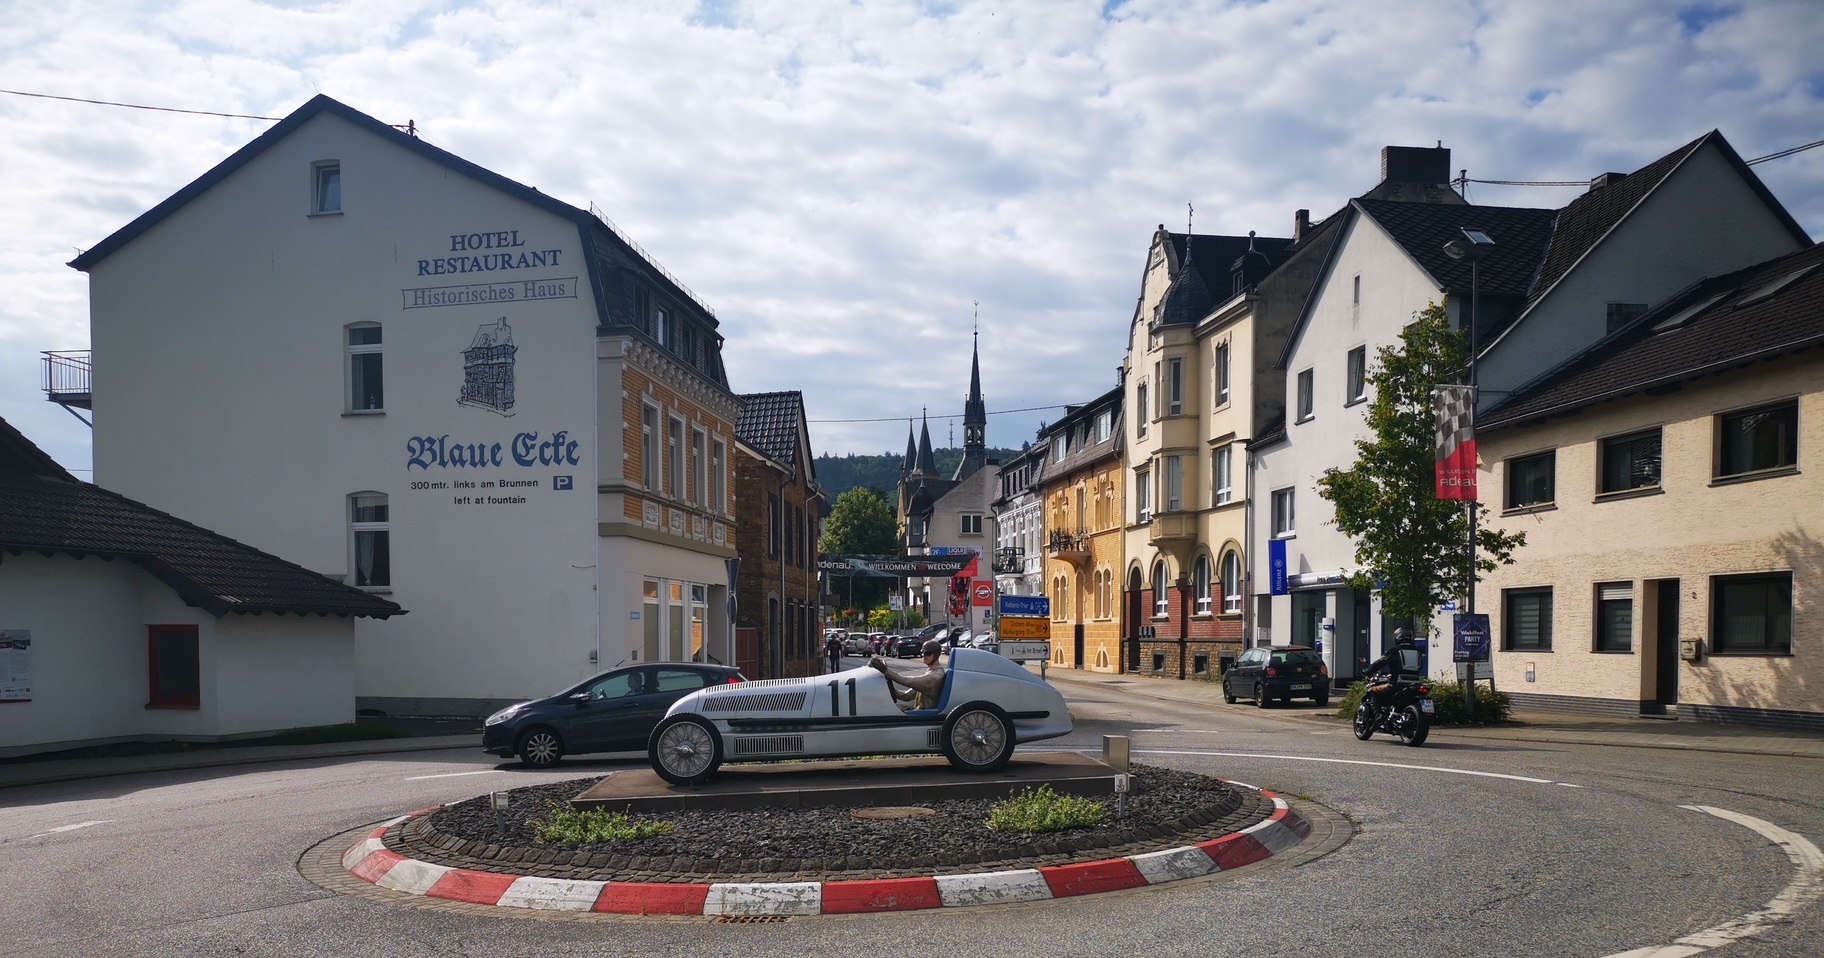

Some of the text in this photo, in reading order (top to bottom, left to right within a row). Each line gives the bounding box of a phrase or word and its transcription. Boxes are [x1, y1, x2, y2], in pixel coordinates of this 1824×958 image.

[450, 230, 526, 251] HOTEL
[417, 249, 562, 276] RESTAURANT
[413, 281, 566, 306] Historisches Haus
[406, 430, 580, 472] Blaue Ecke
[410, 481, 430, 490] 300
[431, 481, 449, 489] mtr.
[453, 480, 476, 489] links
[499, 479, 538, 488] Brunnen
[556, 476, 570, 489] P
[454, 496, 526, 505] left at fountain
[868, 563, 917, 571] WILLKOMMEN
[927, 562, 961, 570] WELCOME
[827, 678, 857, 716] 11
